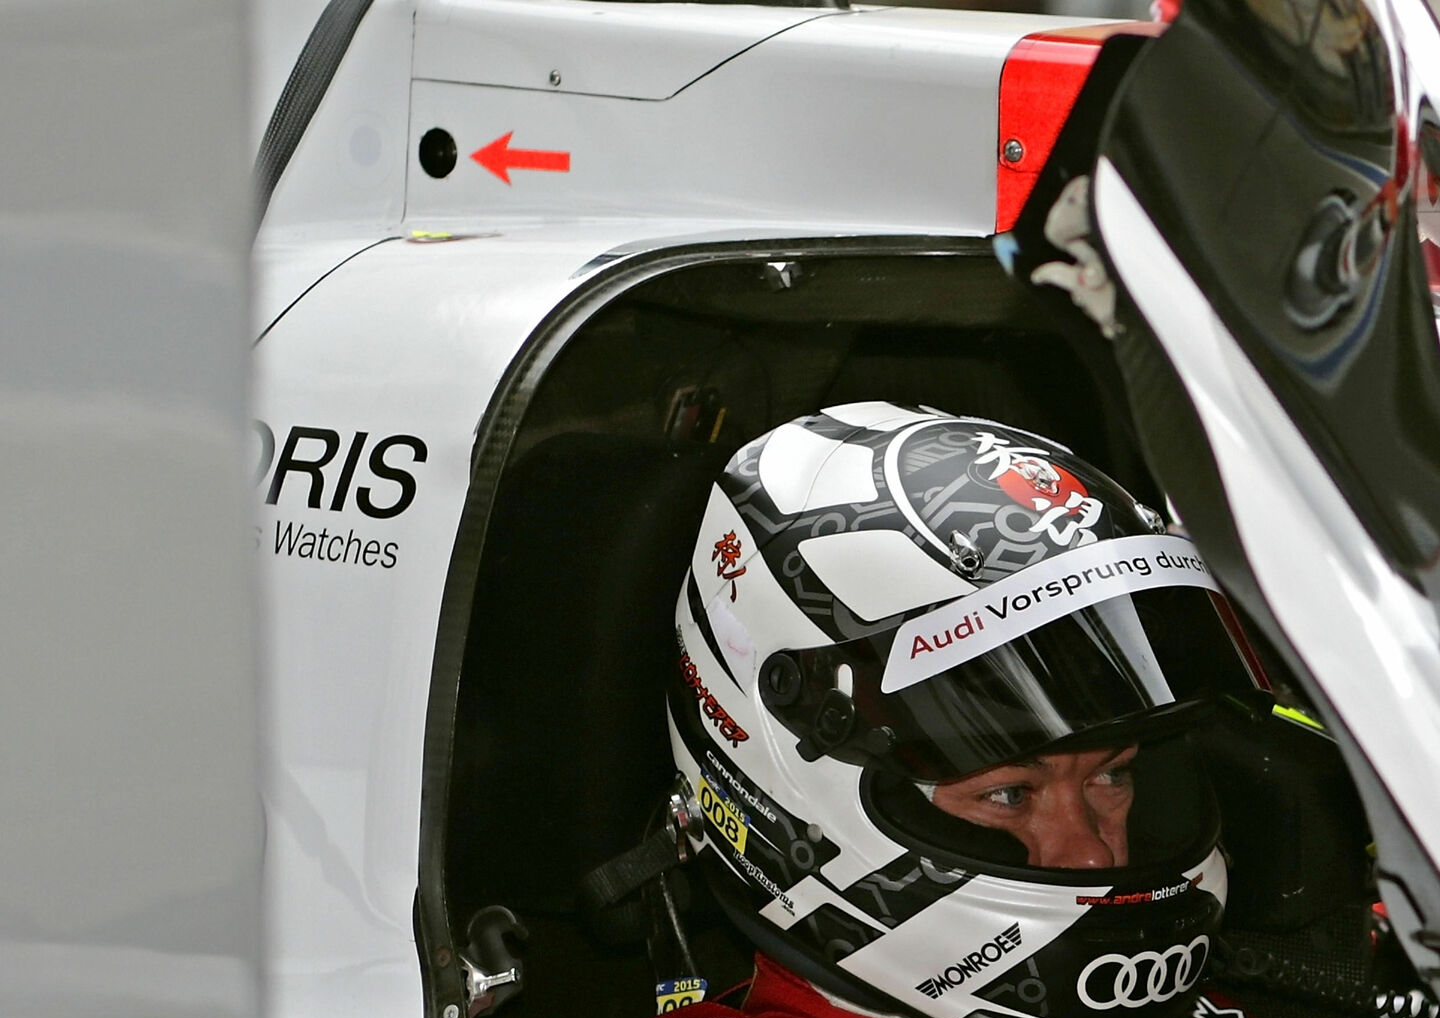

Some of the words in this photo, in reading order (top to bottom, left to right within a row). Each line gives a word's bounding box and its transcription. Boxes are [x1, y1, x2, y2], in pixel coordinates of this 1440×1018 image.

[273, 520, 399, 569] Watches
[909, 611, 985, 660] Audi
[985, 556, 1152, 620] Vorsprung
[701, 786, 739, 843] 008
[706, 750, 778, 824] cannondale
[724, 796, 746, 823] 2015
[673, 979, 701, 992] 2015
[926, 929, 1019, 998] MONROE
